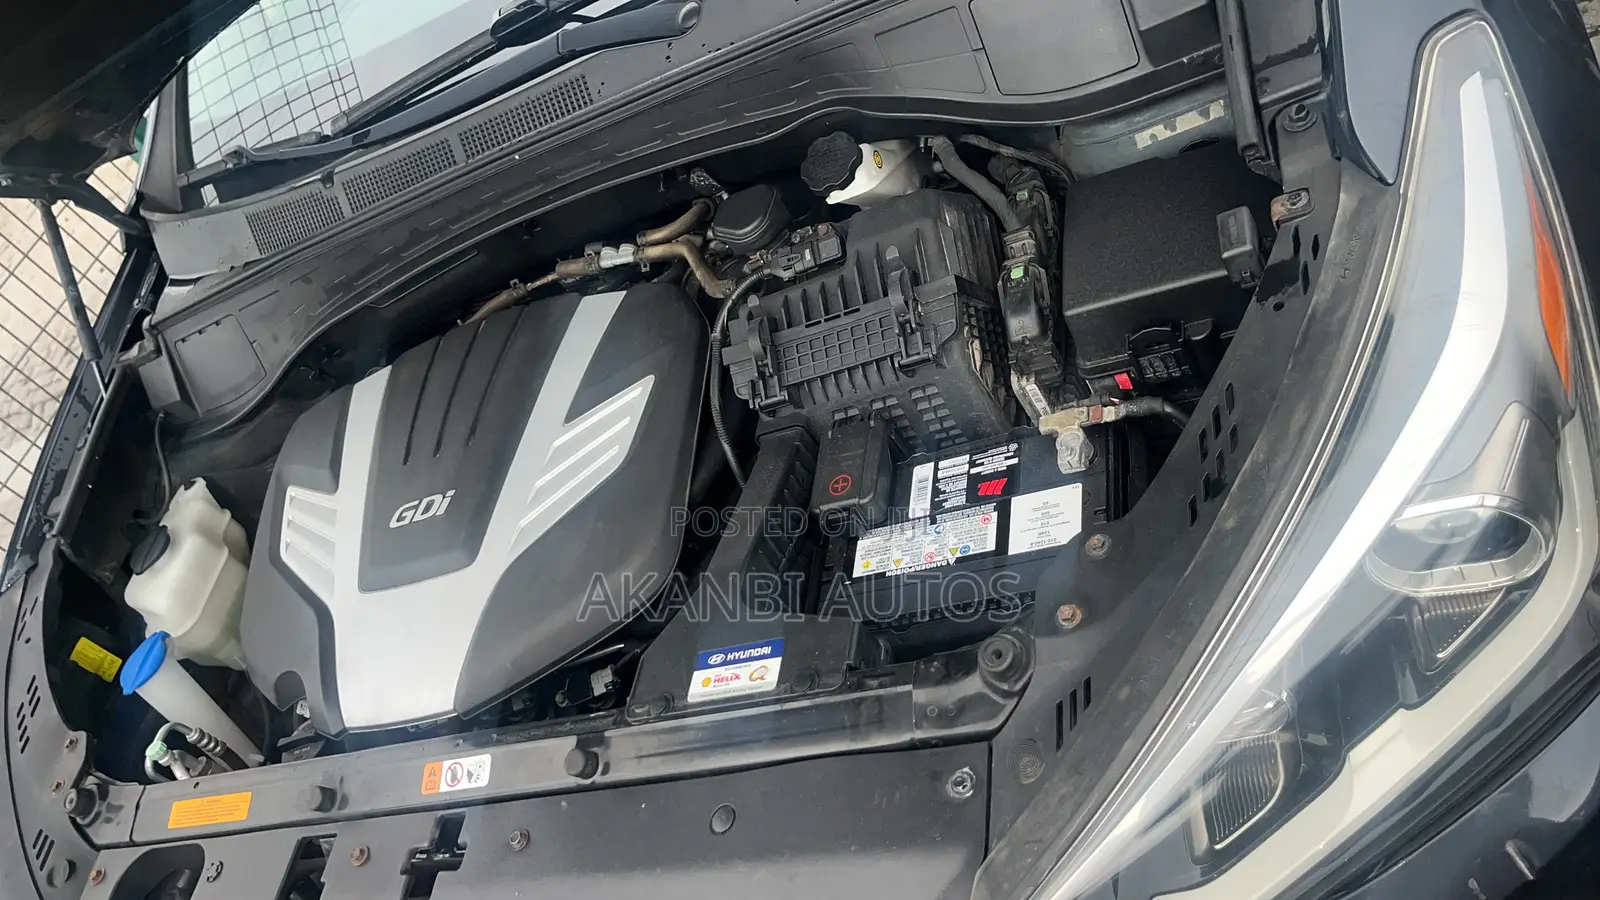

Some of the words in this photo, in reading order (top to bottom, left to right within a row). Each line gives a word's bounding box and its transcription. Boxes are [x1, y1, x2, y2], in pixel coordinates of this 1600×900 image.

[389, 489, 456, 528] GDi
[885, 559, 948, 578] DANGER/POISON
[726, 645, 772, 661] HYUNDAI
[713, 672, 742, 684] HELIX
